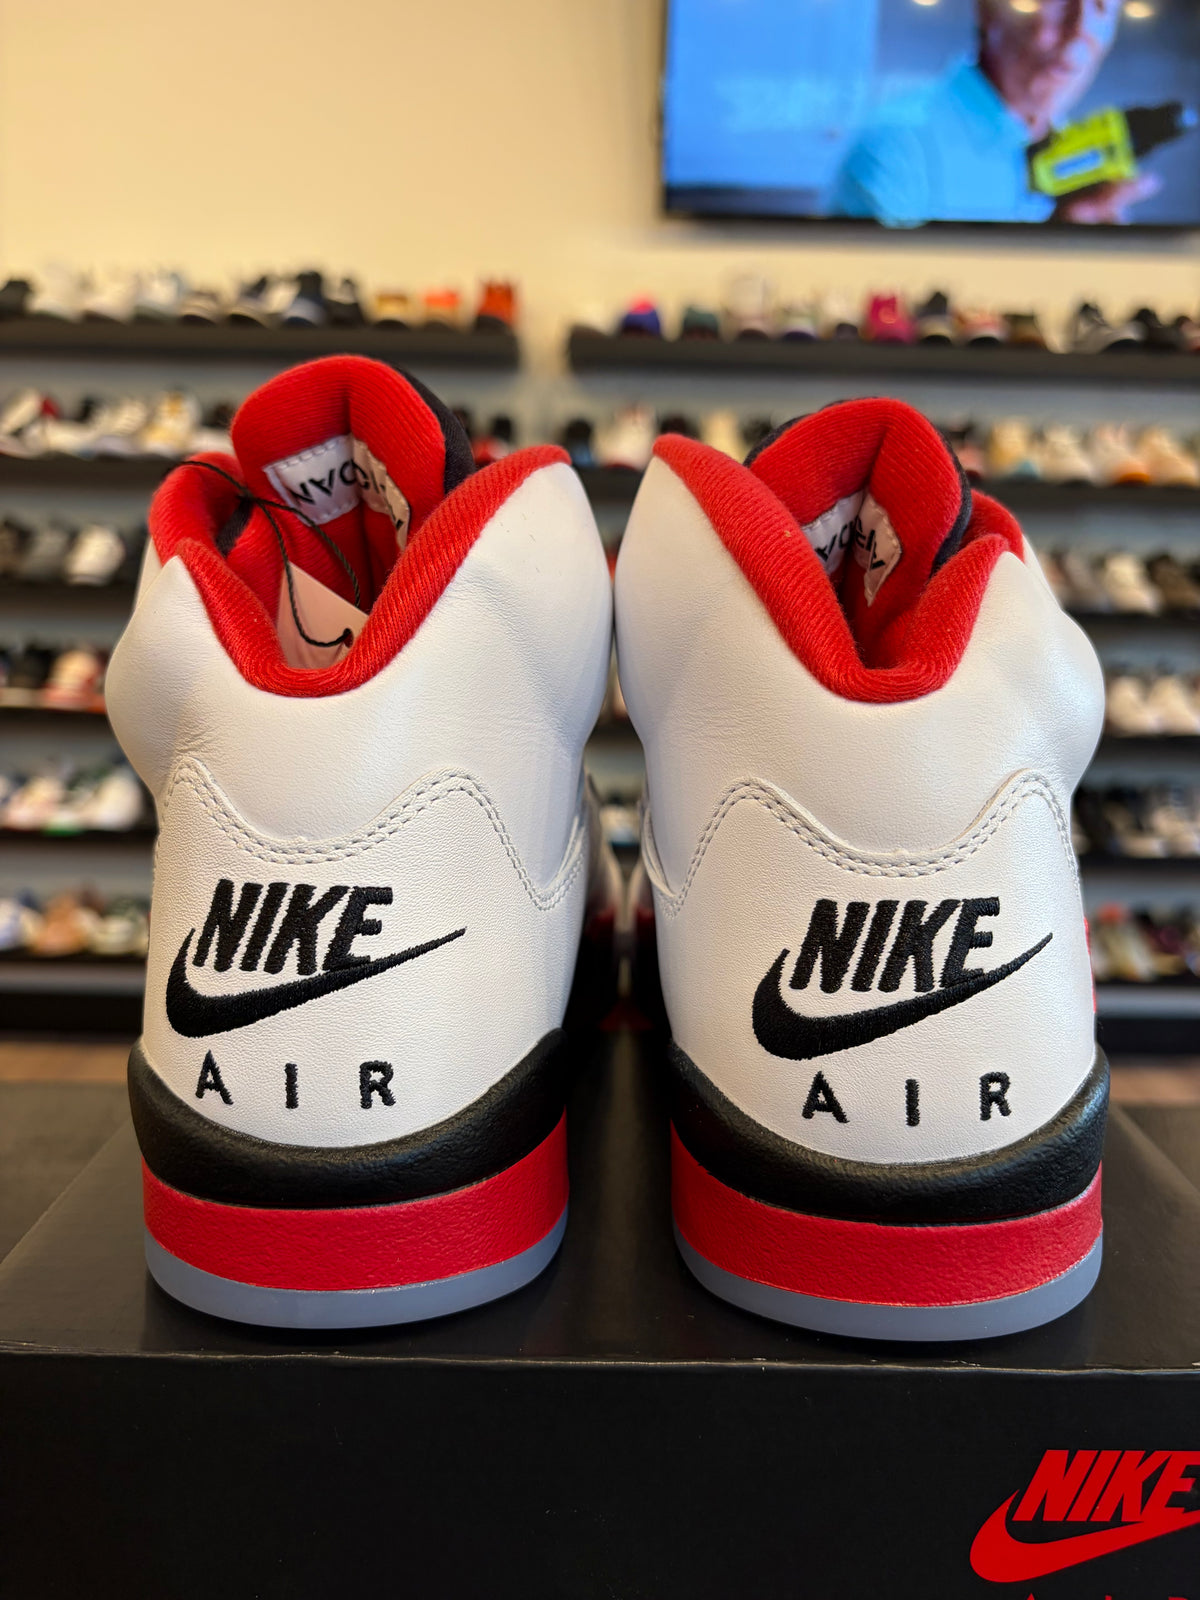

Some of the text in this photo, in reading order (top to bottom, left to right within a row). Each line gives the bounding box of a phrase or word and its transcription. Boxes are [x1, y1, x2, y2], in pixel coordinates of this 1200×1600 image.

[287, 459, 404, 530] RDAN
[193, 879, 393, 976] NIKE
[789, 897, 1000, 993] NIKE
[195, 1050, 396, 1109] AIR
[802, 1071, 1011, 1127] AIR
[1012, 1449, 1200, 1522] NIKE
